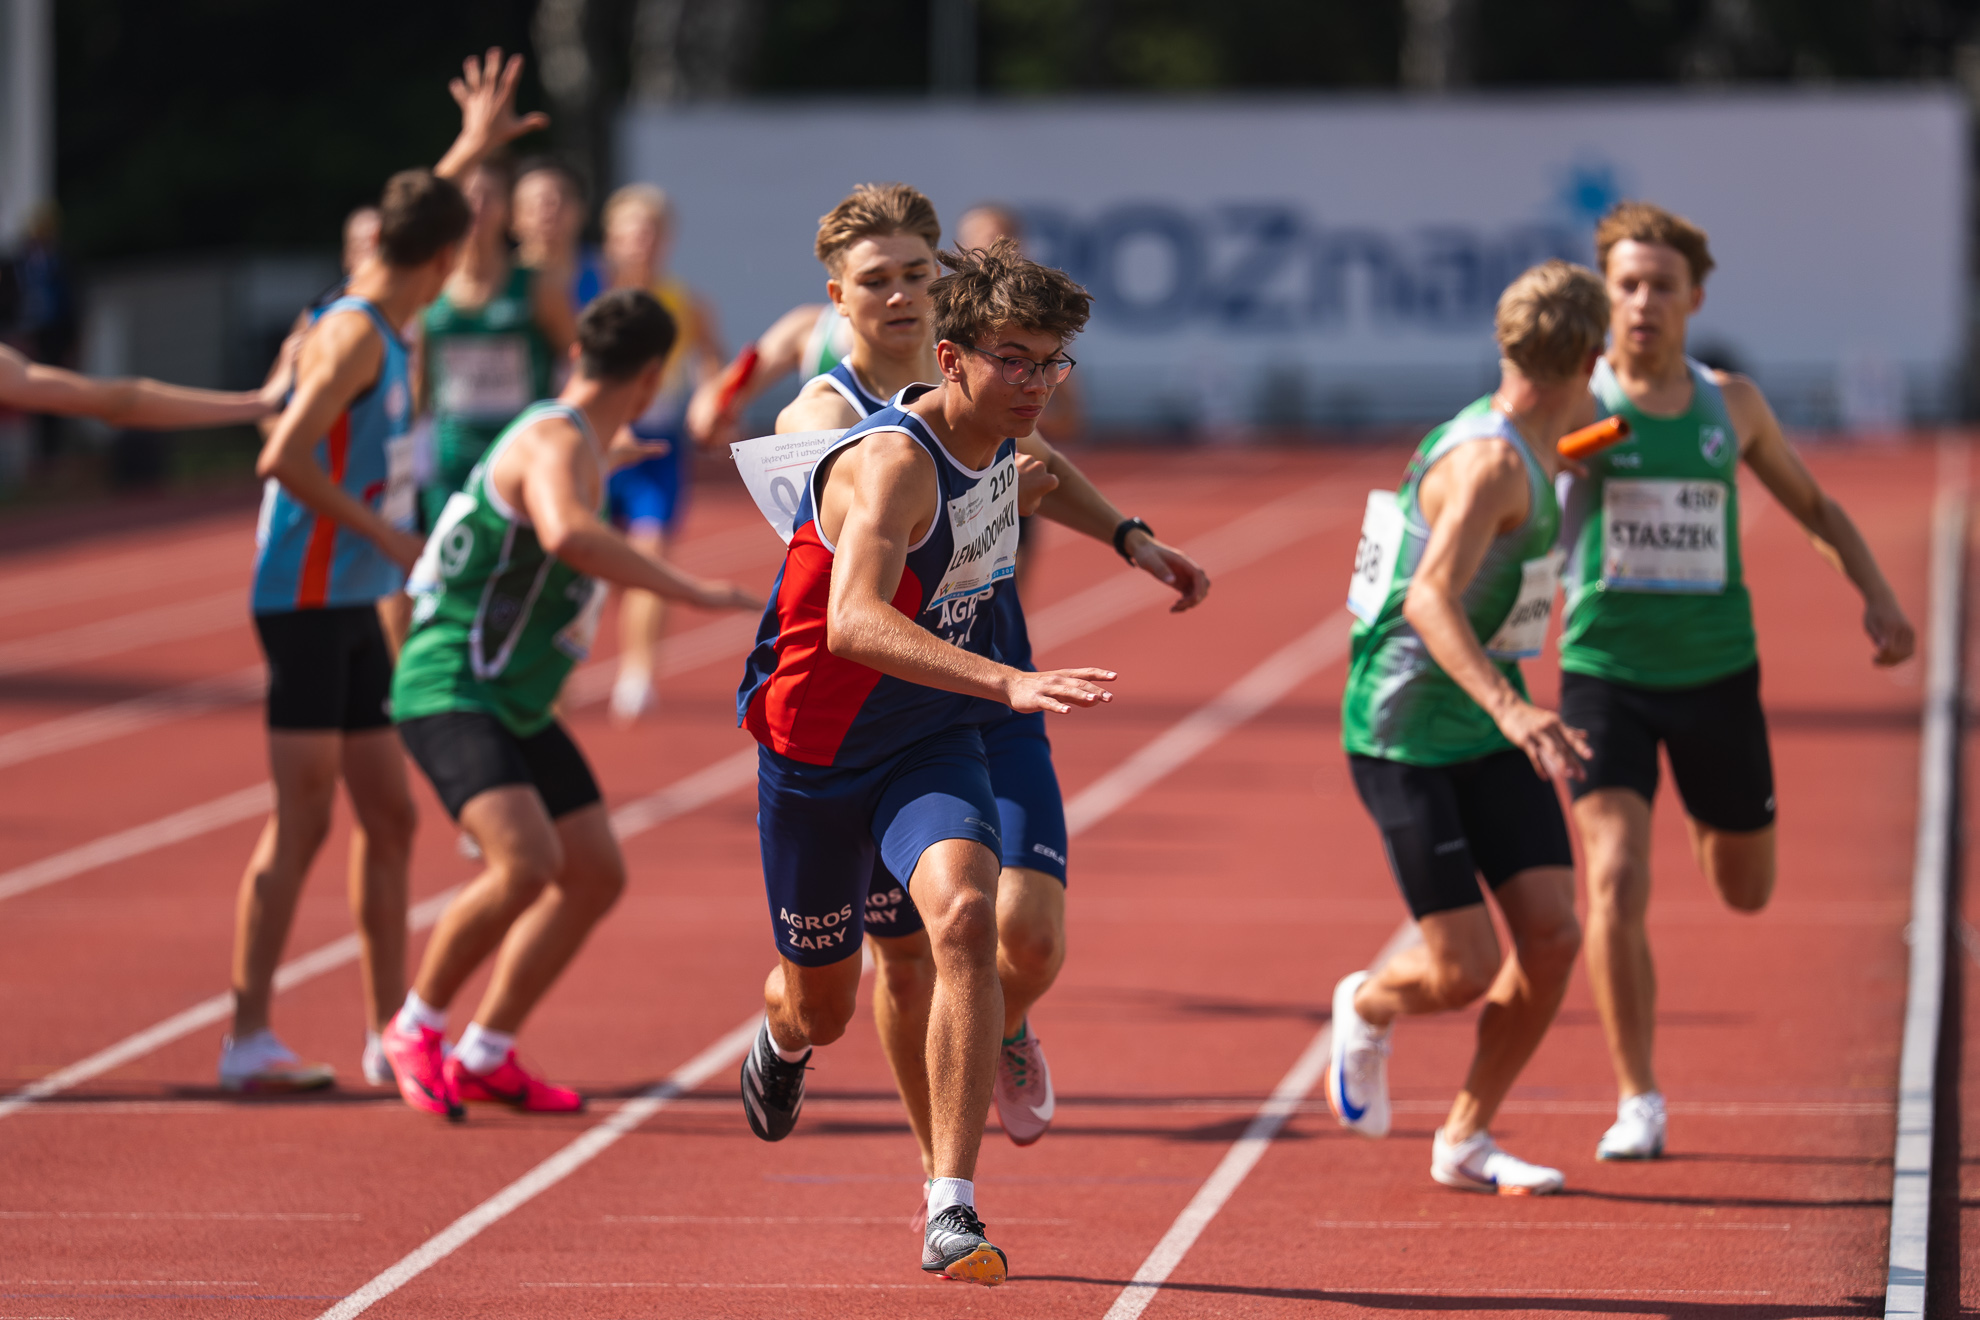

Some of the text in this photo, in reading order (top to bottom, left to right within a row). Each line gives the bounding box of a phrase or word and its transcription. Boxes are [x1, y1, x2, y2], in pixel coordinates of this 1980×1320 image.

[989, 463, 1015, 503] 210
[1611, 520, 1720, 551] STASZEK
[780, 903, 852, 931] AGROS
[788, 926, 847, 950] ŻARY
